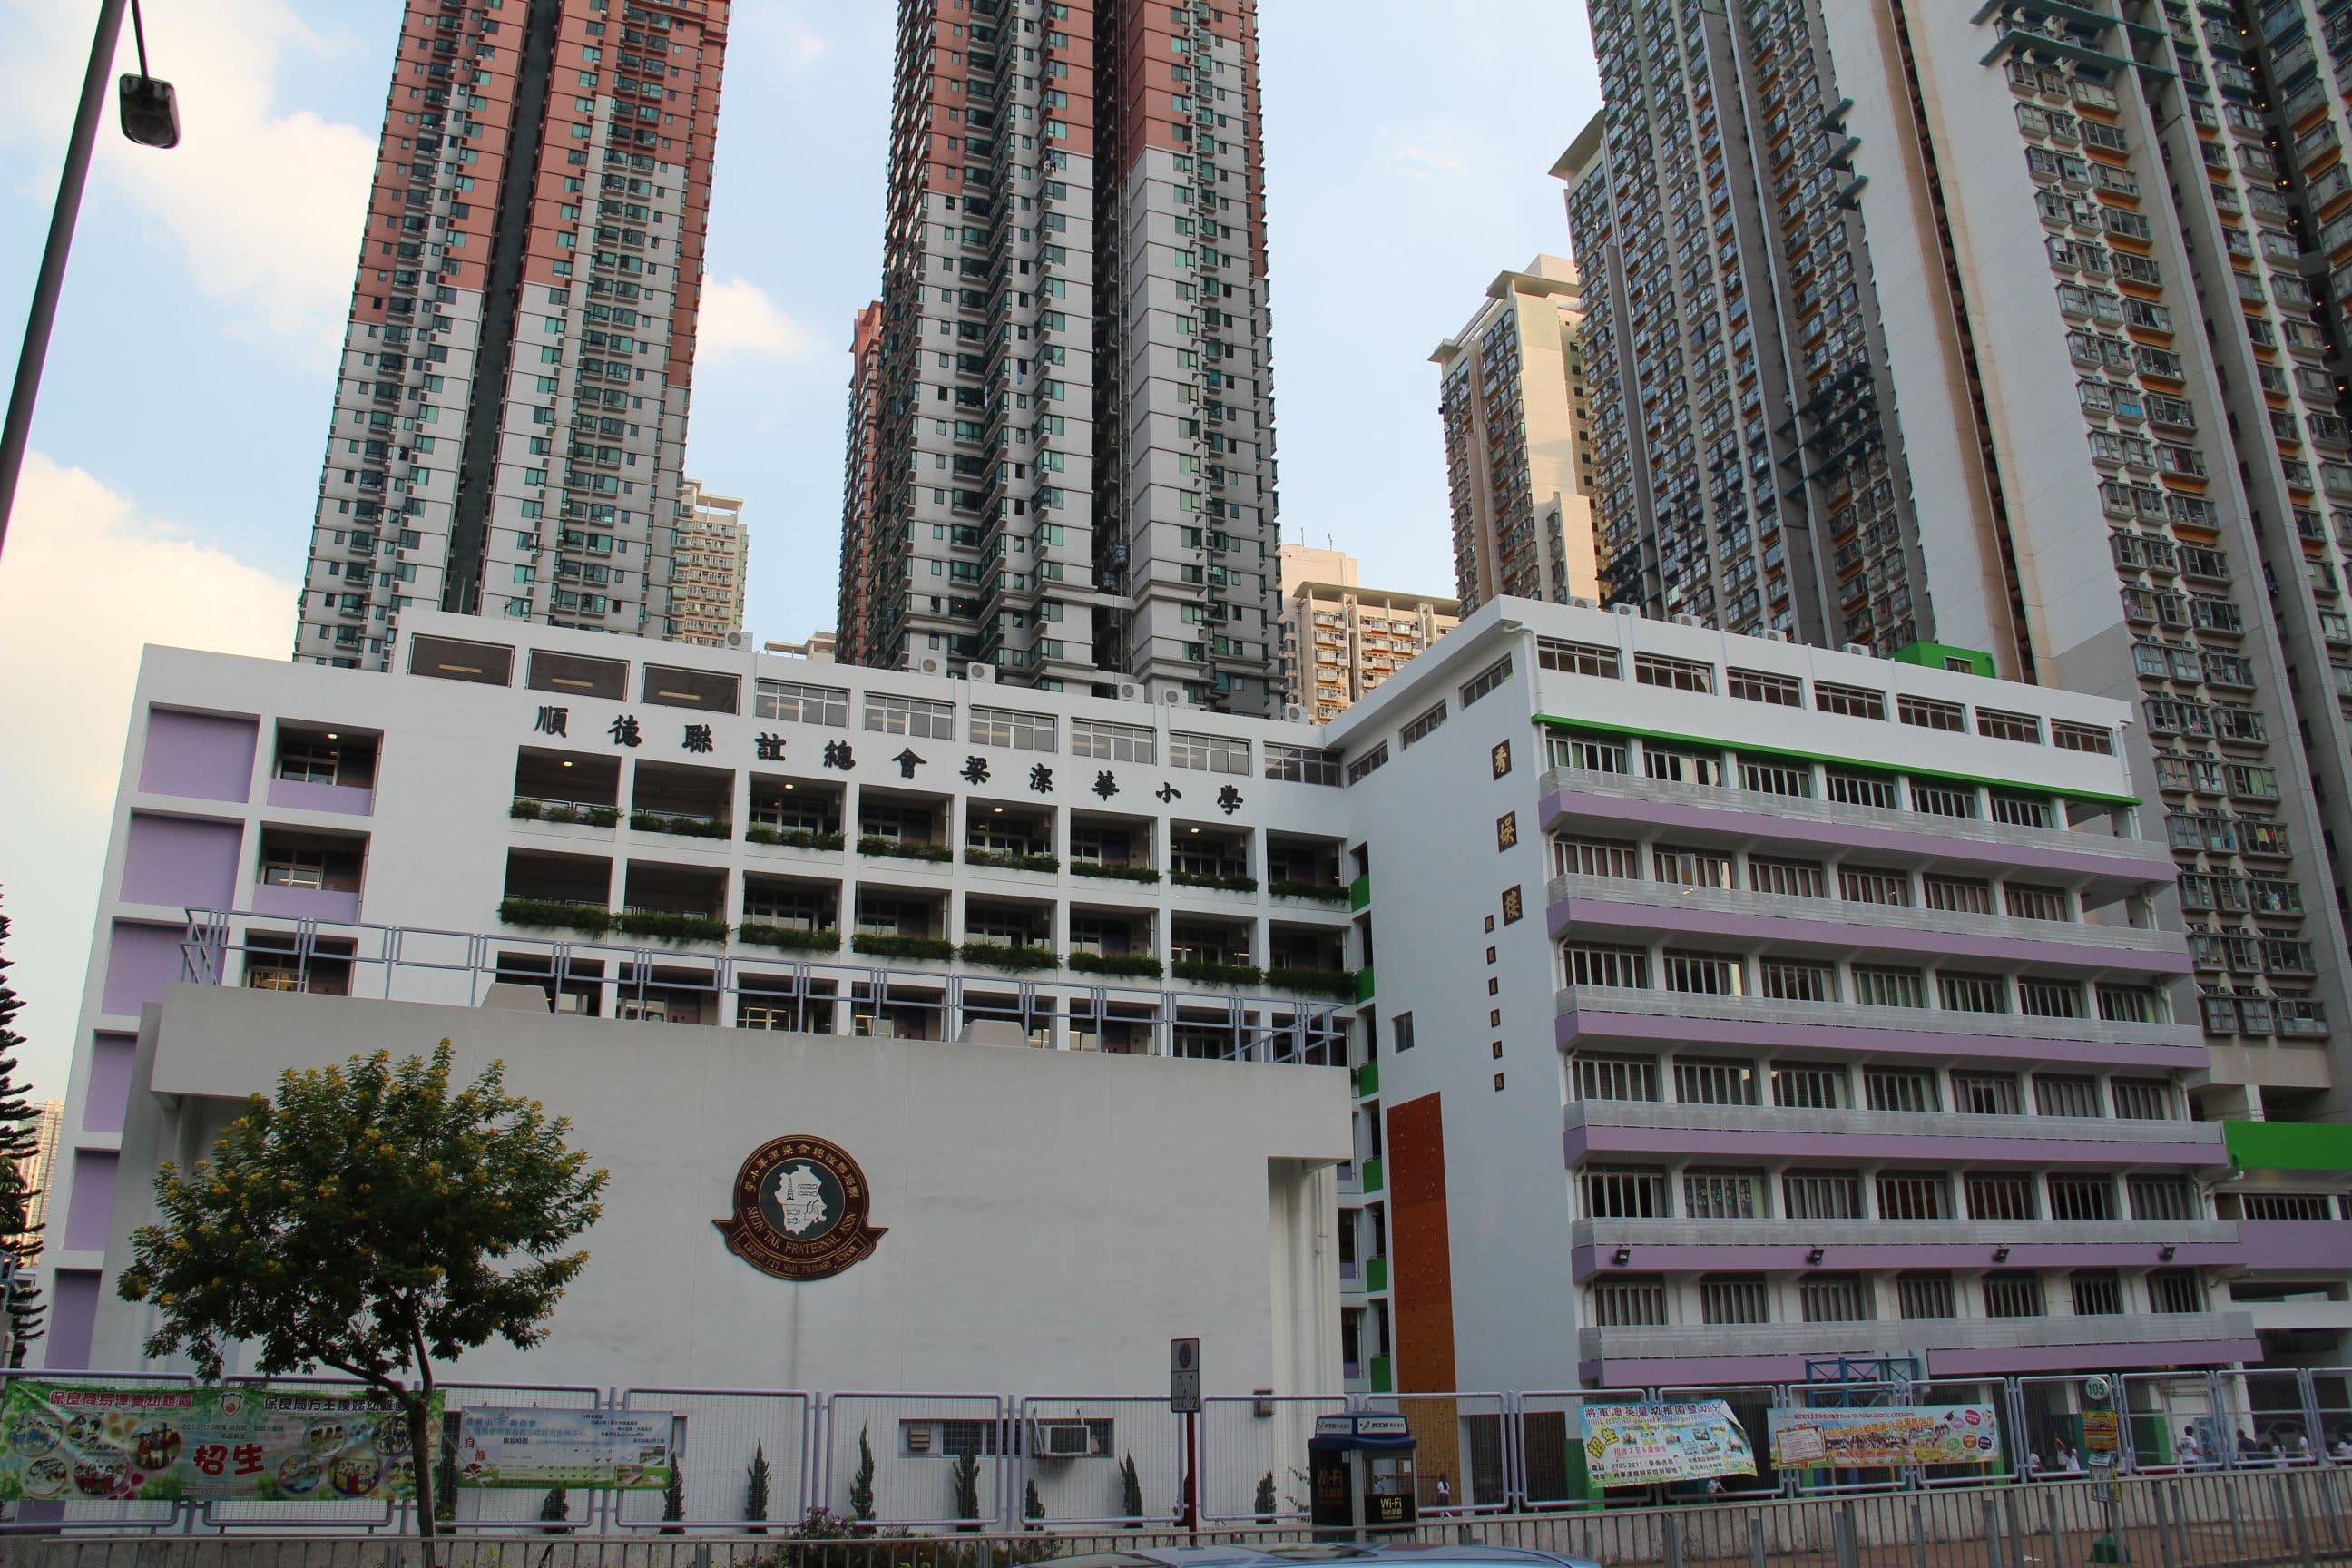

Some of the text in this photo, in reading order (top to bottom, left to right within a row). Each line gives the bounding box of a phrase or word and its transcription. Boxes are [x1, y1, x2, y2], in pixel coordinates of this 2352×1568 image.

[534, 703, 1244, 816] 順德聯誼總會梁潔華小學
[747, 1206, 763, 1231] SHUN
[764, 1230, 781, 1250] TAK
[784, 1235, 841, 1255] FRATERNAL
[1188, 1375, 1193, 1387] 7
[2087, 1383, 2106, 1396] 105
[1189, 1396, 1198, 1408] 12
[1587, 1427, 1620, 1459] 招生
[193, 1443, 264, 1475] 招生
[1380, 1497, 1402, 1509] Wi-Fi
